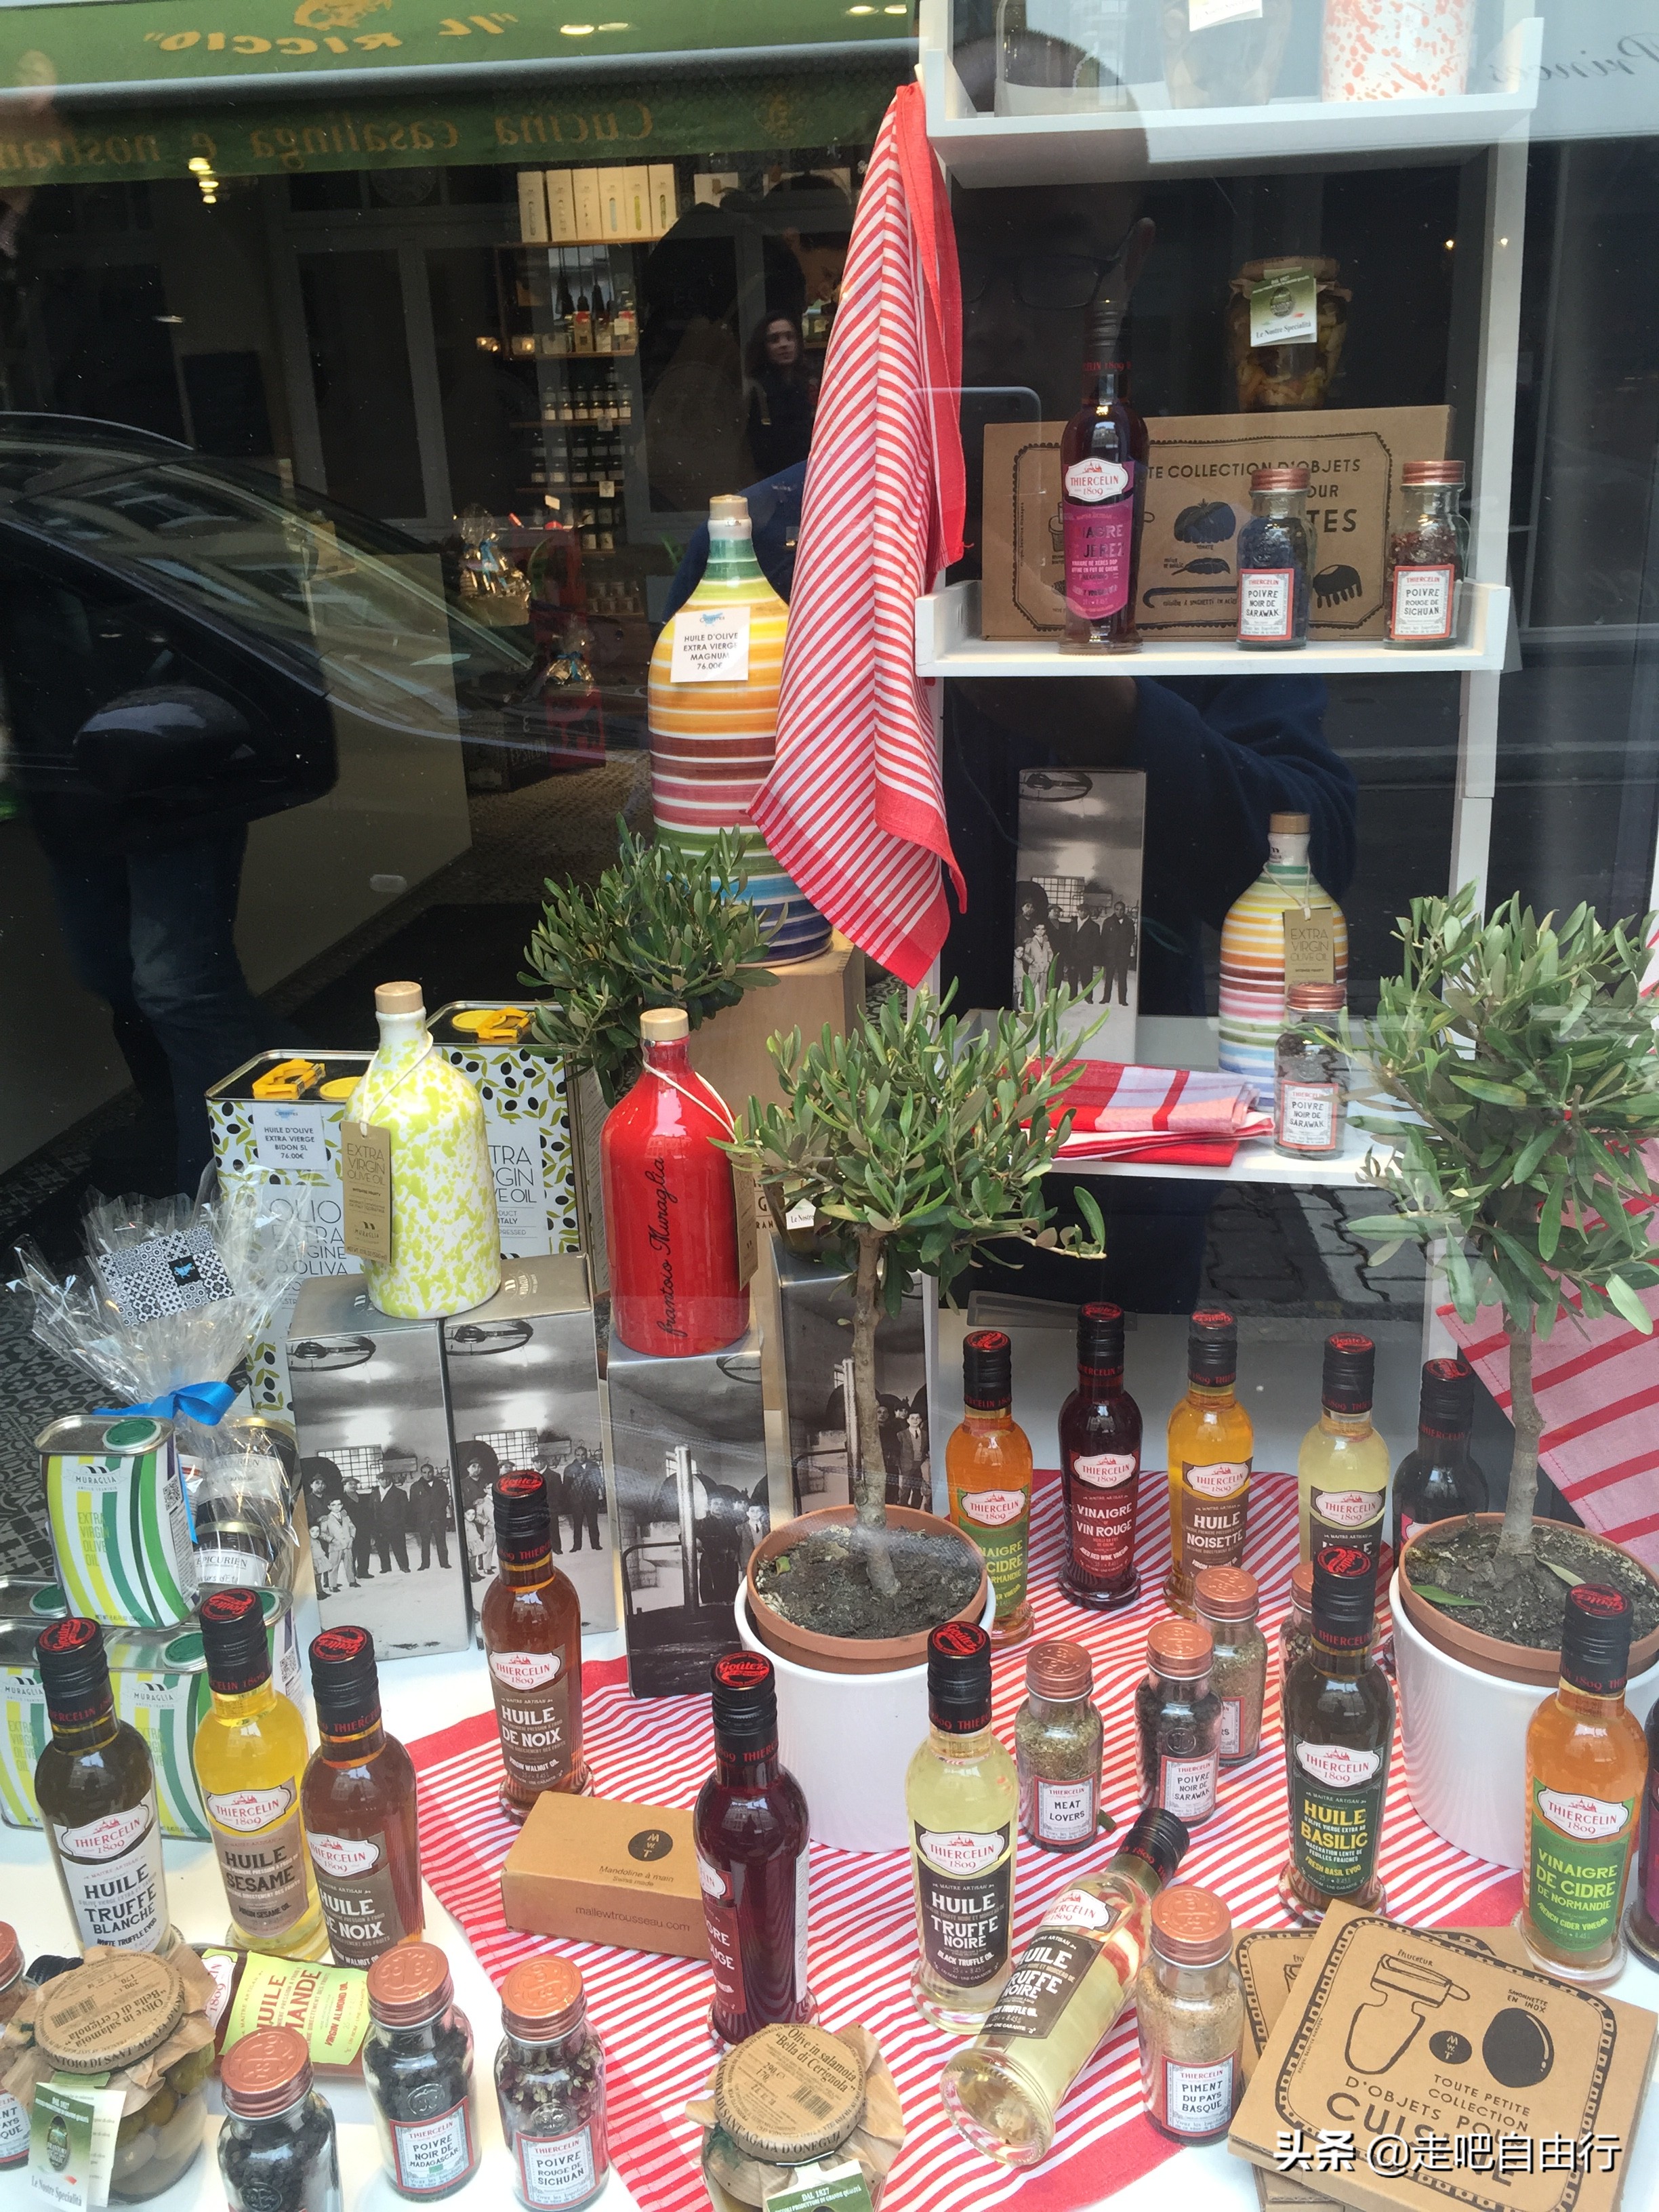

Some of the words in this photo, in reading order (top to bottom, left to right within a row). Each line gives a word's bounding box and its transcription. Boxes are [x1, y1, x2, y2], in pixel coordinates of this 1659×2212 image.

[1168, 462, 1272, 478] COLLECTION
[1071, 476, 1118, 486] THIERCELIN
[1248, 590, 1278, 598] POIVRE
[1406, 588, 1439, 597] POIVRE
[1246, 608, 1279, 617] SARAWAK
[1404, 607, 1439, 615] SICHUAN
[691, 653, 729, 661] MAGNUM
[1290, 928, 1328, 940] EXTRA
[1291, 941, 1328, 951] VIRGIN
[1292, 1102, 1324, 1110] POIVRE
[1290, 1119, 1324, 1128] SARAWAK
[347, 1143, 384, 1161] EXTRA
[348, 1158, 385, 1174] VIRGIN
[347, 1170, 371, 1183] OLIVE
[373, 1175, 386, 1185] OIL
[511, 1189, 537, 1203] OIL
[269, 1198, 342, 1224] OLIO
[645, 1158, 678, 1255] Muraglia
[1082, 1464, 1130, 1475] THIERCELIN
[1196, 1473, 1243, 1486] THIERCELIN
[970, 1500, 1019, 1512] THIERCELIN
[1077, 1502, 1132, 1518] VINAIGRE
[1324, 1502, 1376, 1513] THIERCELIN
[78, 1512, 105, 1524] EXTRA
[1194, 1511, 1240, 1529] HUILE
[1076, 1521, 1094, 1536] VIN
[1096, 1519, 1132, 1537] ROUGE
[1187, 1529, 1243, 1548] NOISETTE
[986, 1555, 1023, 1573] CIDRE
[496, 1663, 550, 1676] THIERCELIN
[134, 1692, 173, 1701] MURAGLIA
[501, 1705, 555, 1725] HUILE
[502, 1725, 518, 1745] DE
[522, 1727, 562, 1747] NOIX
[1178, 1763, 1211, 1773] THIERCELIN
[1305, 1753, 1369, 1773] THIERCELIN
[1177, 1772, 1210, 1784] POIVRE
[1324, 1771, 1350, 1783] 1809
[1199, 1782, 1208, 1790] DE
[1174, 1789, 1210, 1801] SARAWAK
[216, 1799, 279, 1818] THIERCELIN
[1054, 1800, 1081, 1809] MEAT
[1304, 1799, 1366, 1826] HUILE
[235, 1817, 262, 1825] 1809
[1050, 1811, 1085, 1822] LOVERS
[1549, 1801, 1617, 1825] THIERCELIN
[73, 1818, 141, 1847] THIERCELIN
[1300, 1820, 1368, 1849] BASILIC
[1568, 1822, 1595, 1834] 1809
[98, 1840, 125, 1853] 1809
[310, 1841, 366, 1862] THIERCELIN
[930, 1843, 994, 1859] THIERCELIN
[1339, 1849, 1355, 1857] LENTE
[224, 1846, 287, 1868] HUILE
[949, 1860, 976, 1869] 1809
[1538, 1847, 1618, 1879] VINAIGRE
[599, 1866, 643, 1878] Mandoline
[653, 1874, 674, 1883] main
[1305, 1856, 1323, 1872] FRESH
[1324, 1867, 1344, 1877] BASIL
[84, 1863, 149, 1899] HUILE
[226, 1865, 295, 1892] SESAME
[1536, 1864, 1557, 1889] DE
[1561, 1880, 1616, 1898] CIDRE
[84, 1883, 157, 1923] TRUFFE
[319, 1887, 375, 1916] HUILE
[931, 1891, 996, 1914] HUILE
[1537, 1884, 1549, 1899] DE
[1551, 1892, 1612, 1911] NORMANDIE
[93, 1902, 155, 1934] BLANCHE
[930, 1914, 999, 1938] TRUFFE
[1560, 1918, 1580, 1930] CIDER
[1582, 1917, 1608, 1930] VINEGAR
[118, 1931, 144, 1946] TRUFFLE
[339, 1921, 385, 1940] NOIX
[944, 1935, 987, 1949] NOIRE
[346, 1955, 371, 1966] WALNUT
[937, 1950, 957, 1965] BLACK
[958, 1957, 985, 1966] TRUFFLE
[210, 1983, 226, 2012] 1809
[1002, 1984, 1042, 1999] NOIRE
[121, 2004, 132, 2014] di
[136, 1999, 163, 2017] Olive
[1524, 2001, 1546, 2013] INOX
[123, 2013, 136, 2023] in
[75, 2020, 121, 2048] salamoia
[788, 2028, 811, 2048] Olive
[809, 2043, 820, 2055] in
[819, 2053, 857, 2083] salamoia
[797, 2049, 809, 2062] di
[1181, 2070, 1223, 2078] THIERCELIN
[1182, 2081, 1223, 2092] PIMENT
[1199, 2091, 1221, 2102] PAYS
[1345, 2076, 1441, 2121] D'OBJETS
[1433, 2074, 1479, 2097] TOUTE
[1484, 2093, 1530, 2116] PETITE
[1182, 2100, 1222, 2112] BASQUE
[1429, 2089, 1528, 2132] COLLECTION
[409, 2121, 453, 2139] THIERCELIN
[413, 2134, 453, 2152] POIVRE
[415, 2147, 440, 2160] NOIR
[441, 2142, 453, 2155] DE
[535, 2139, 579, 2154] THIERCELIN
[410, 2148, 459, 2168] MADAGASCAR
[537, 2150, 581, 2167] POIVRE
[537, 2167, 570, 2176] ROUGE
[571, 2161, 582, 2171] DE
[537, 2167, 584, 2186] SICHUAN
[56, 2187, 81, 2206] Specialità
[802, 2191, 815, 2201] DAL
[815, 2188, 830, 2198] 1827
